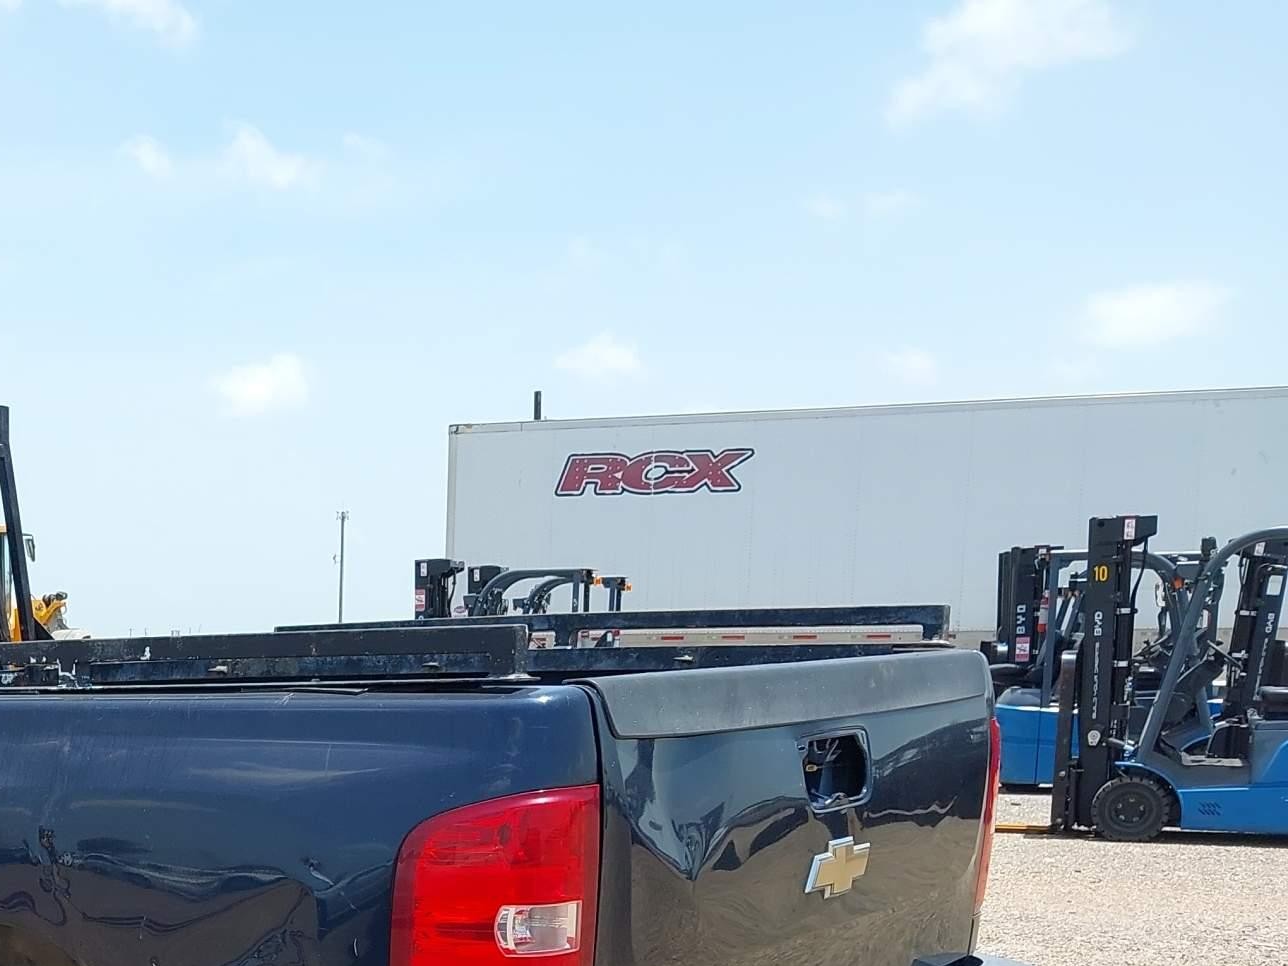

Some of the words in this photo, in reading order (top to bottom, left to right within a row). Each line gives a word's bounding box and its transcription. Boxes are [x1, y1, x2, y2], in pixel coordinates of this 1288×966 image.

[555, 448, 755, 496] RCX
[1093, 565, 1109, 582] 10
[1016, 604, 1027, 635] BYD
[1094, 611, 1103, 637] BYD
